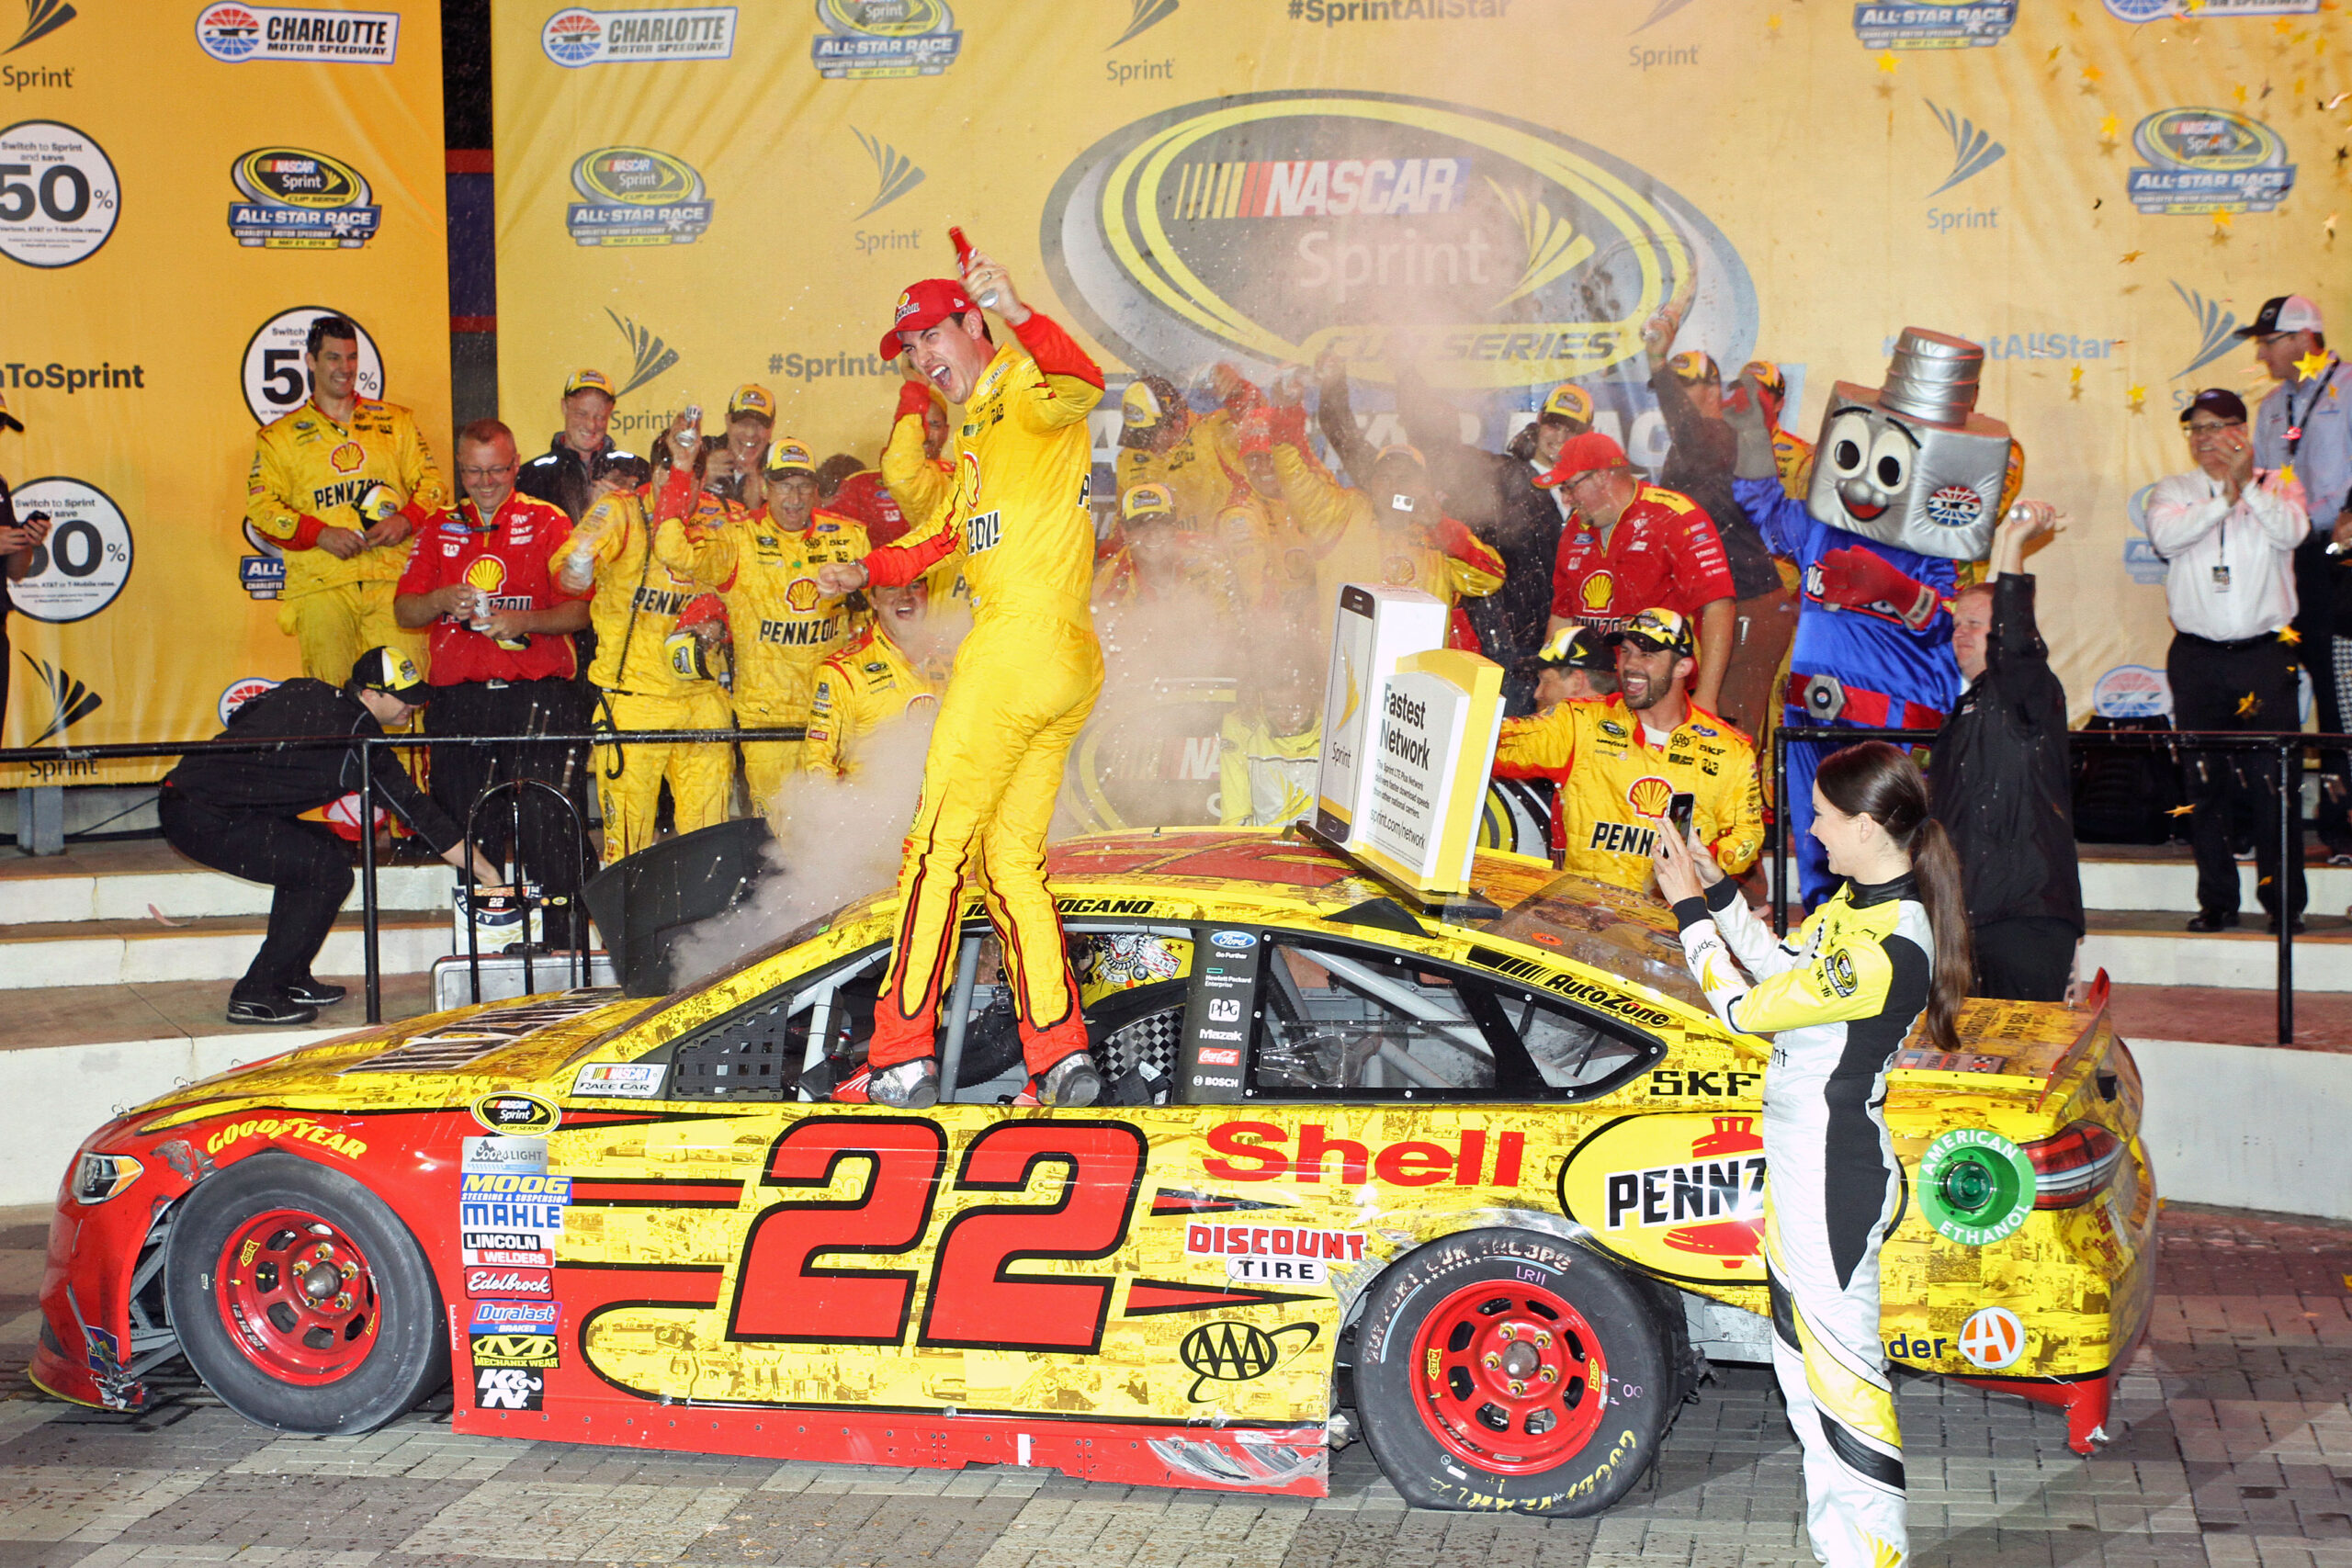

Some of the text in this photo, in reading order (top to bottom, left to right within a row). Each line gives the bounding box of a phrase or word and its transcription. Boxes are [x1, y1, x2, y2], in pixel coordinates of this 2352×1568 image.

[865, 5, 903, 19] Sprint
[1286, 0, 1509, 23] #SprintAllStar
[1860, 7, 2007, 25] ALL-STAR RACE
[267, 17, 388, 45] CHARLOTTE
[607, 17, 724, 44] CHARLOTTE
[267, 42, 388, 56] MOTOR SPEEDWAY
[608, 40, 724, 54] MOTOR SPEEDWAY
[818, 38, 954, 56] ALL-STAR RACE
[1628, 44, 1698, 71] Sprint
[3, 65, 74, 90] Sprint
[1106, 60, 1172, 85] Sprint
[2, 141, 84, 152] Switch to Sprint
[2187, 136, 2231, 152] Sprnt
[20, 152, 65, 162] and save
[614, 159, 650, 172] NASCAR
[277, 160, 315, 174] NASCAR
[282, 175, 322, 191] Sprint
[618, 173, 657, 189] Sprint
[1263, 158, 1459, 218] NASCAR
[2134, 173, 2286, 188] ALL-STAR RACE
[236, 209, 373, 226] ALL-STAR RACE
[573, 207, 705, 223] ALL-STAR RACE
[1927, 208, 1998, 234] Sprint
[854, 228, 920, 255] Sprint
[1295, 230, 1490, 303] Sprint
[272, 327, 306, 336] Switch
[1443, 331, 1620, 360] SERIES
[610, 408, 673, 435] Sprint
[15, 499, 96, 508] Switch to Sprint
[759, 615, 840, 645] PENNZOIL
[1384, 682, 1426, 730] Fastest
[1380, 718, 1431, 772] Network
[1699, 744, 1726, 756] SKF
[1331, 741, 1351, 769] Sprint
[29, 758, 98, 778] Sprint
[1384, 762, 1394, 777] Sprint
[1408, 774, 1423, 791] Network
[1389, 779, 1399, 792] faster
[1399, 784, 1417, 803] download
[1417, 794, 1430, 809] speeds
[1382, 791, 1391, 804] other
[1391, 795, 1405, 812] national
[1406, 803, 1420, 819] carriers.
[1370, 808, 1426, 851] sprint.com/network
[488, 897, 504, 908] 22
[1056, 900, 1155, 915] OGANO
[1218, 932, 1247, 947] Ford
[1144, 952, 1174, 972] LOGANO
[1225, 952, 1248, 960] Further
[1204, 975, 1252, 984] Hewlett Packard
[1211, 1000, 1238, 1017] PPG
[1544, 974, 1672, 1029] AutoZone
[1199, 1029, 1242, 1042] Mazak
[608, 1067, 650, 1080] NASCAR
[1204, 1077, 1238, 1088] BOSCH
[580, 1082, 650, 1092] RACE CAR
[1650, 1070, 1761, 1097] SKF
[497, 1100, 531, 1110] NASCAR
[499, 1109, 531, 1122] Sprint
[207, 1117, 368, 1160] GOODYEAR
[510, 1150, 542, 1161] LIGHT
[1203, 1121, 1525, 1188] Shell
[1921, 1129, 2019, 1177] AMERICAN
[462, 1175, 571, 1194] MOOG
[461, 1192, 568, 1204] STEERING & SUSPENSION
[463, 1203, 560, 1228] MAHLE
[1939, 1203, 2031, 1245] ETHANOL
[467, 1235, 538, 1250] LINCOLN
[724, 1115, 1148, 1355] 22
[1188, 1224, 1365, 1261] DISCOUNT
[483, 1250, 547, 1265] WELDERS
[1238, 1260, 1316, 1280] TIRE
[468, 1270, 551, 1293] Edelbrock
[477, 1303, 556, 1322] Duralast
[498, 1325, 537, 1334] BRAKES
[1194, 1322, 1274, 1380] AAA
[474, 1355, 559, 1368] MECHANIX WEAR
